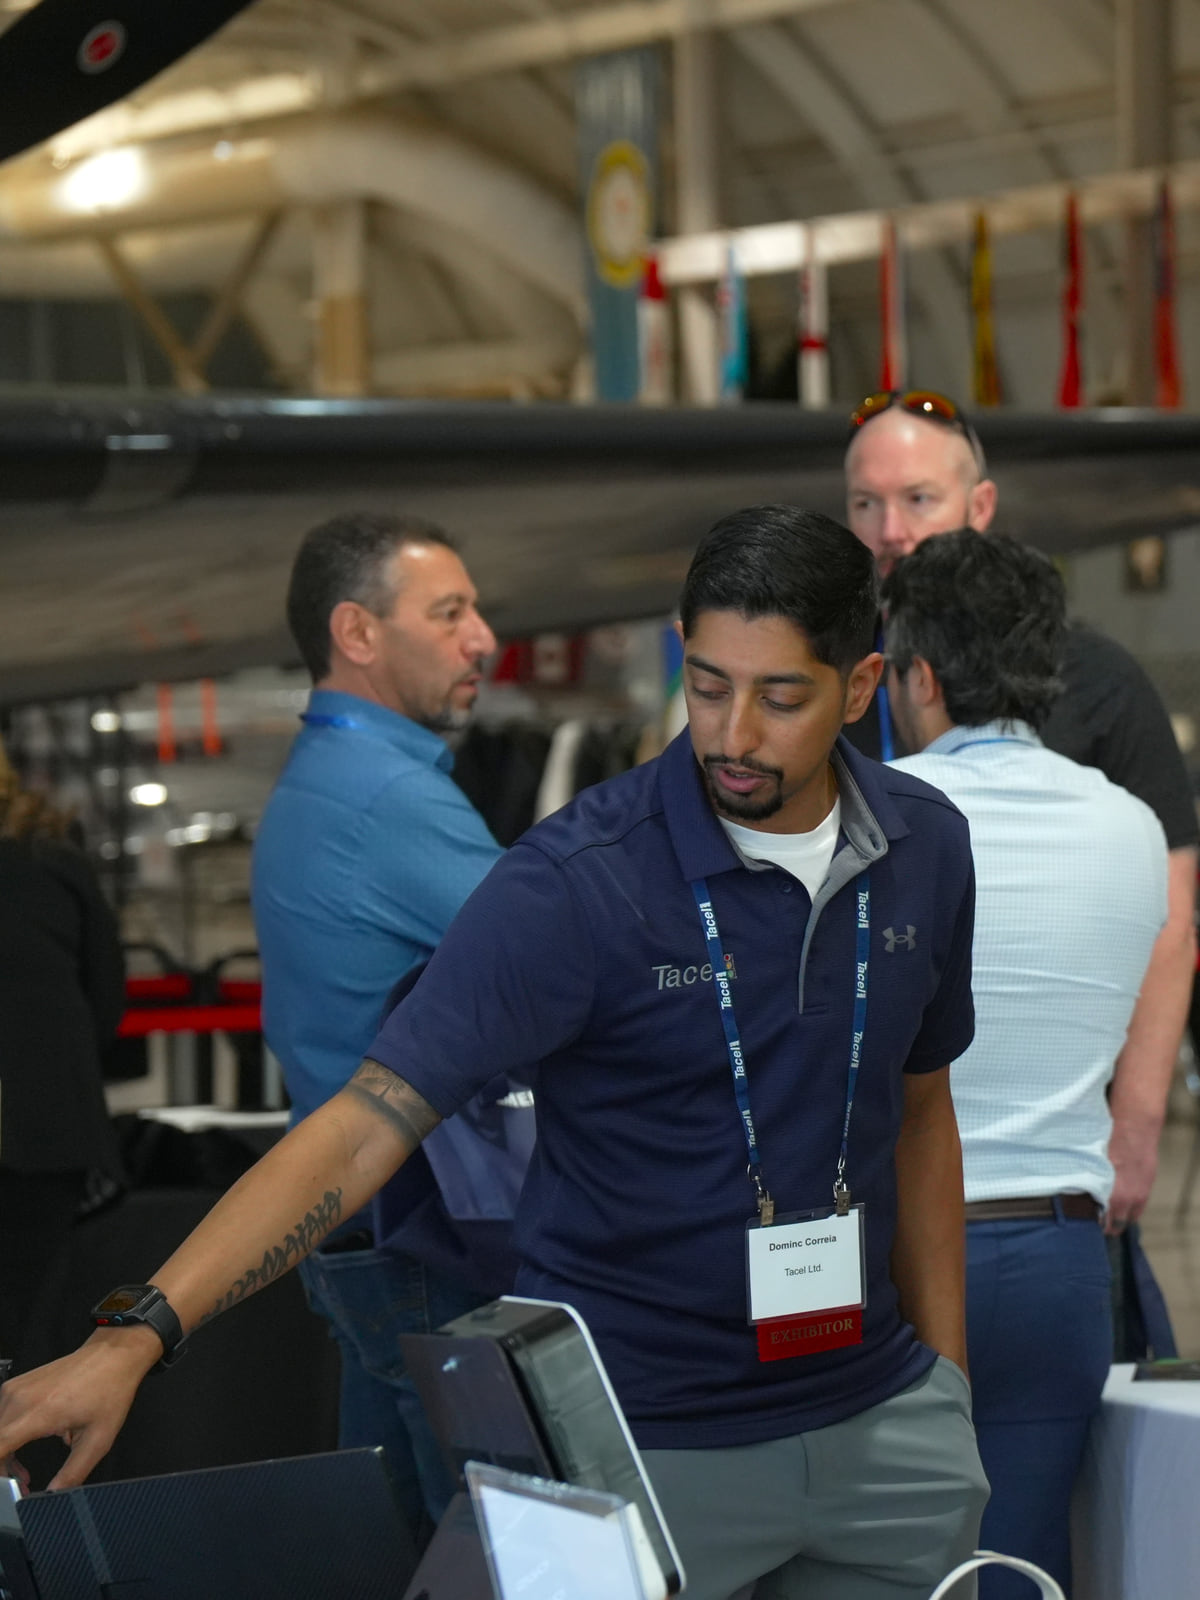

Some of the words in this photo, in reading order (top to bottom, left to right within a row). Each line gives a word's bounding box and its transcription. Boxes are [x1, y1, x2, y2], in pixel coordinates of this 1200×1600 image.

[651, 963, 714, 990] Tace
[769, 1240, 803, 1252] Dominc
[805, 1235, 838, 1247] Correia
[784, 1266, 806, 1277] Tacel
[808, 1264, 824, 1274] Ltd.
[770, 1318, 855, 1345] EXHIBITOR
